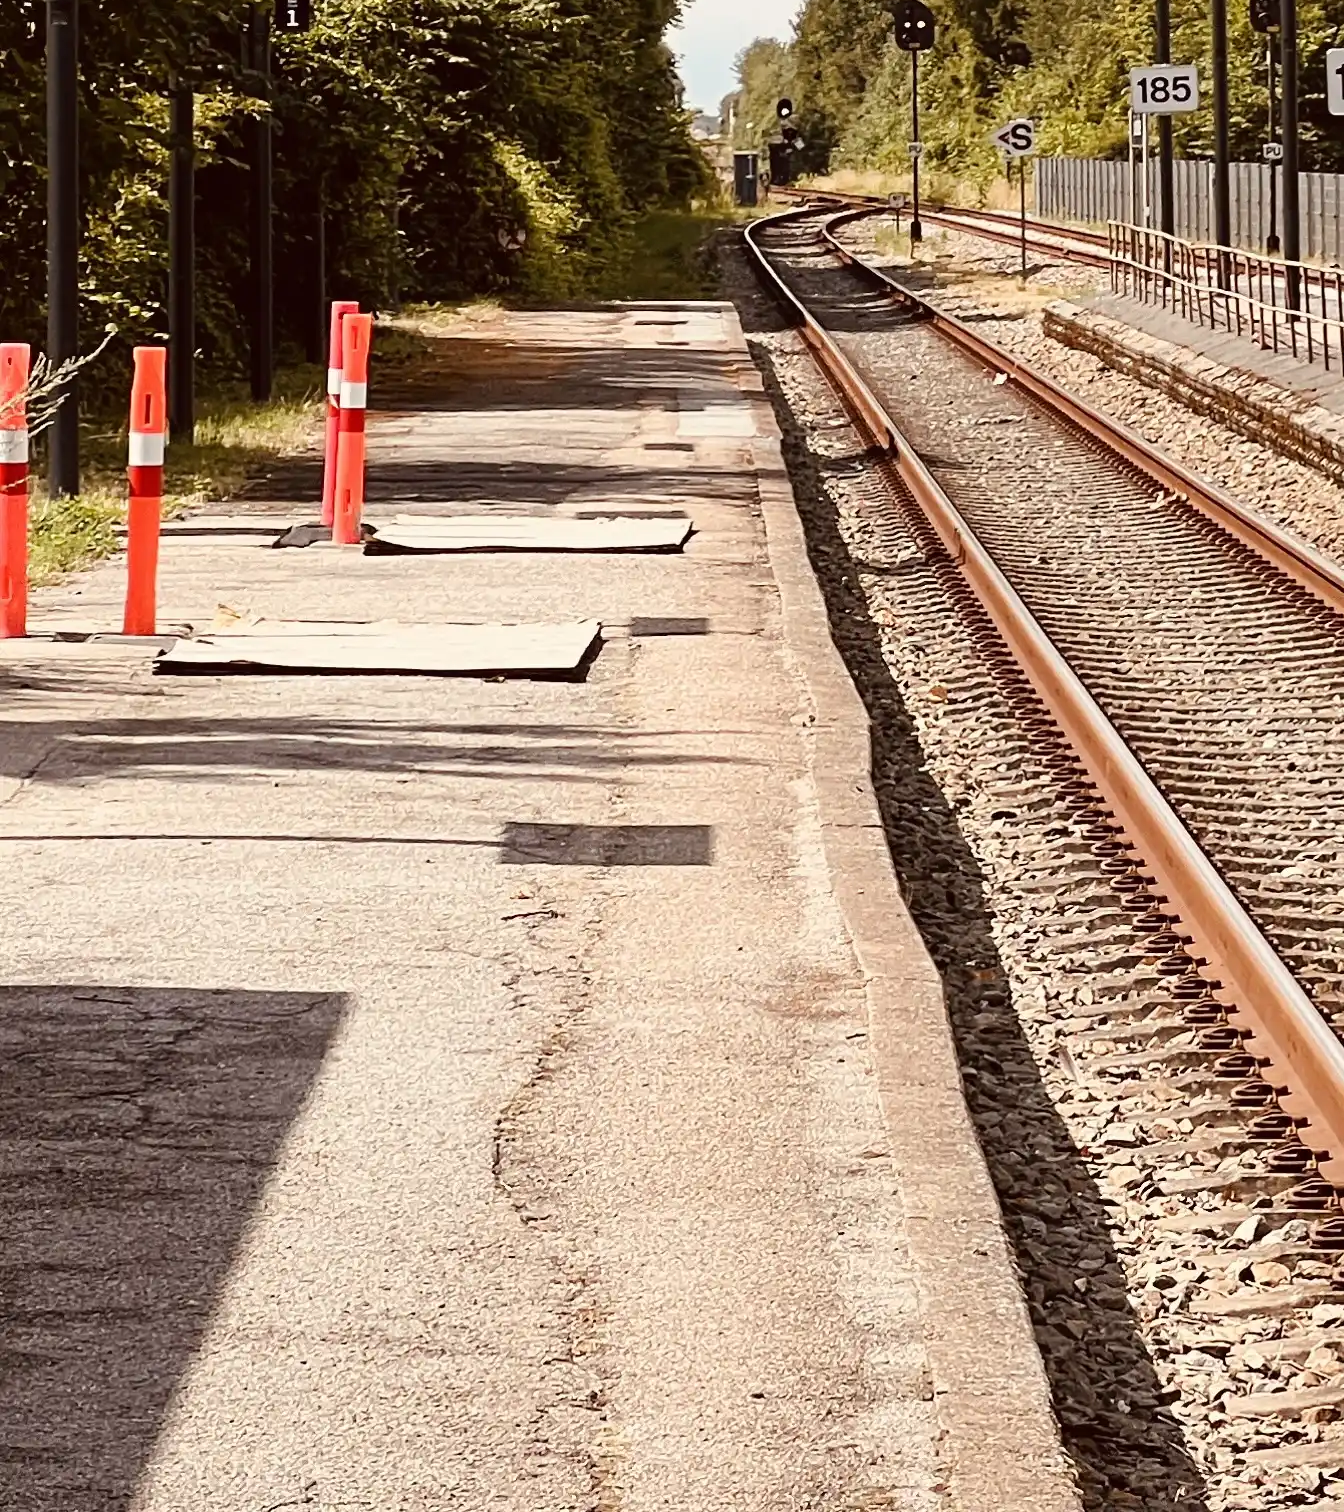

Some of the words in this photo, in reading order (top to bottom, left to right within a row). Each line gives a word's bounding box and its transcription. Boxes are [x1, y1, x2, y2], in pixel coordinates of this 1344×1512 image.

[286, 10, 299, 27] 1
[1137, 76, 1191, 103] 185
[1011, 123, 1032, 150] S
